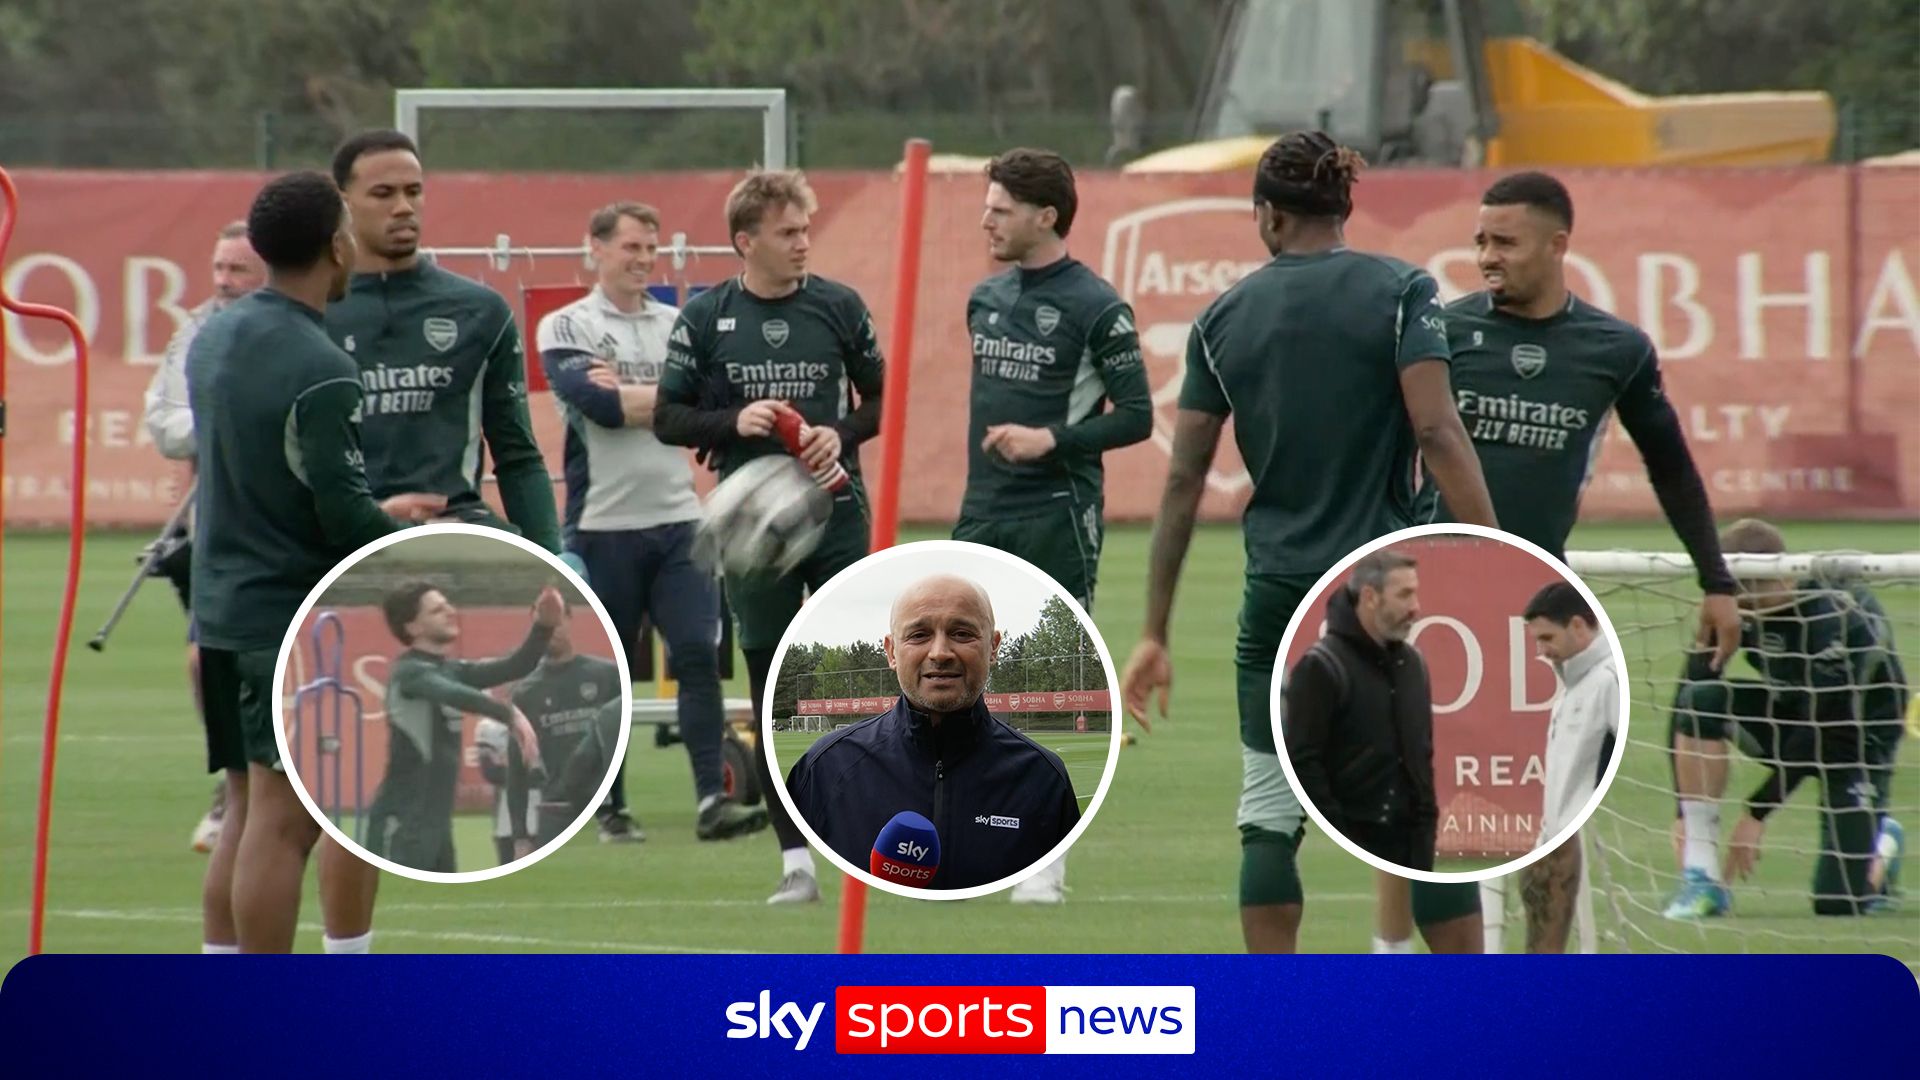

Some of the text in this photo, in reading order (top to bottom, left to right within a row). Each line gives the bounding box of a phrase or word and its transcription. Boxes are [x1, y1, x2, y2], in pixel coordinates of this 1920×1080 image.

[1137, 252, 1268, 296] Arse
[973, 333, 1056, 365] Emirates
[1473, 331, 1484, 346] 9
[362, 363, 454, 391] mirates
[726, 360, 829, 383] Emirates
[744, 381, 816, 399] FLY BETTER
[380, 390, 435, 415] BETTER
[1457, 389, 1589, 429] Emirates
[1473, 418, 1568, 450] FLY BETTER
[1711, 467, 1855, 493] CENTRE
[975, 815, 1018, 827] sky sports
[1443, 814, 1547, 832] AININ
[897, 840, 929, 861] sky
[882, 862, 930, 879] sports
